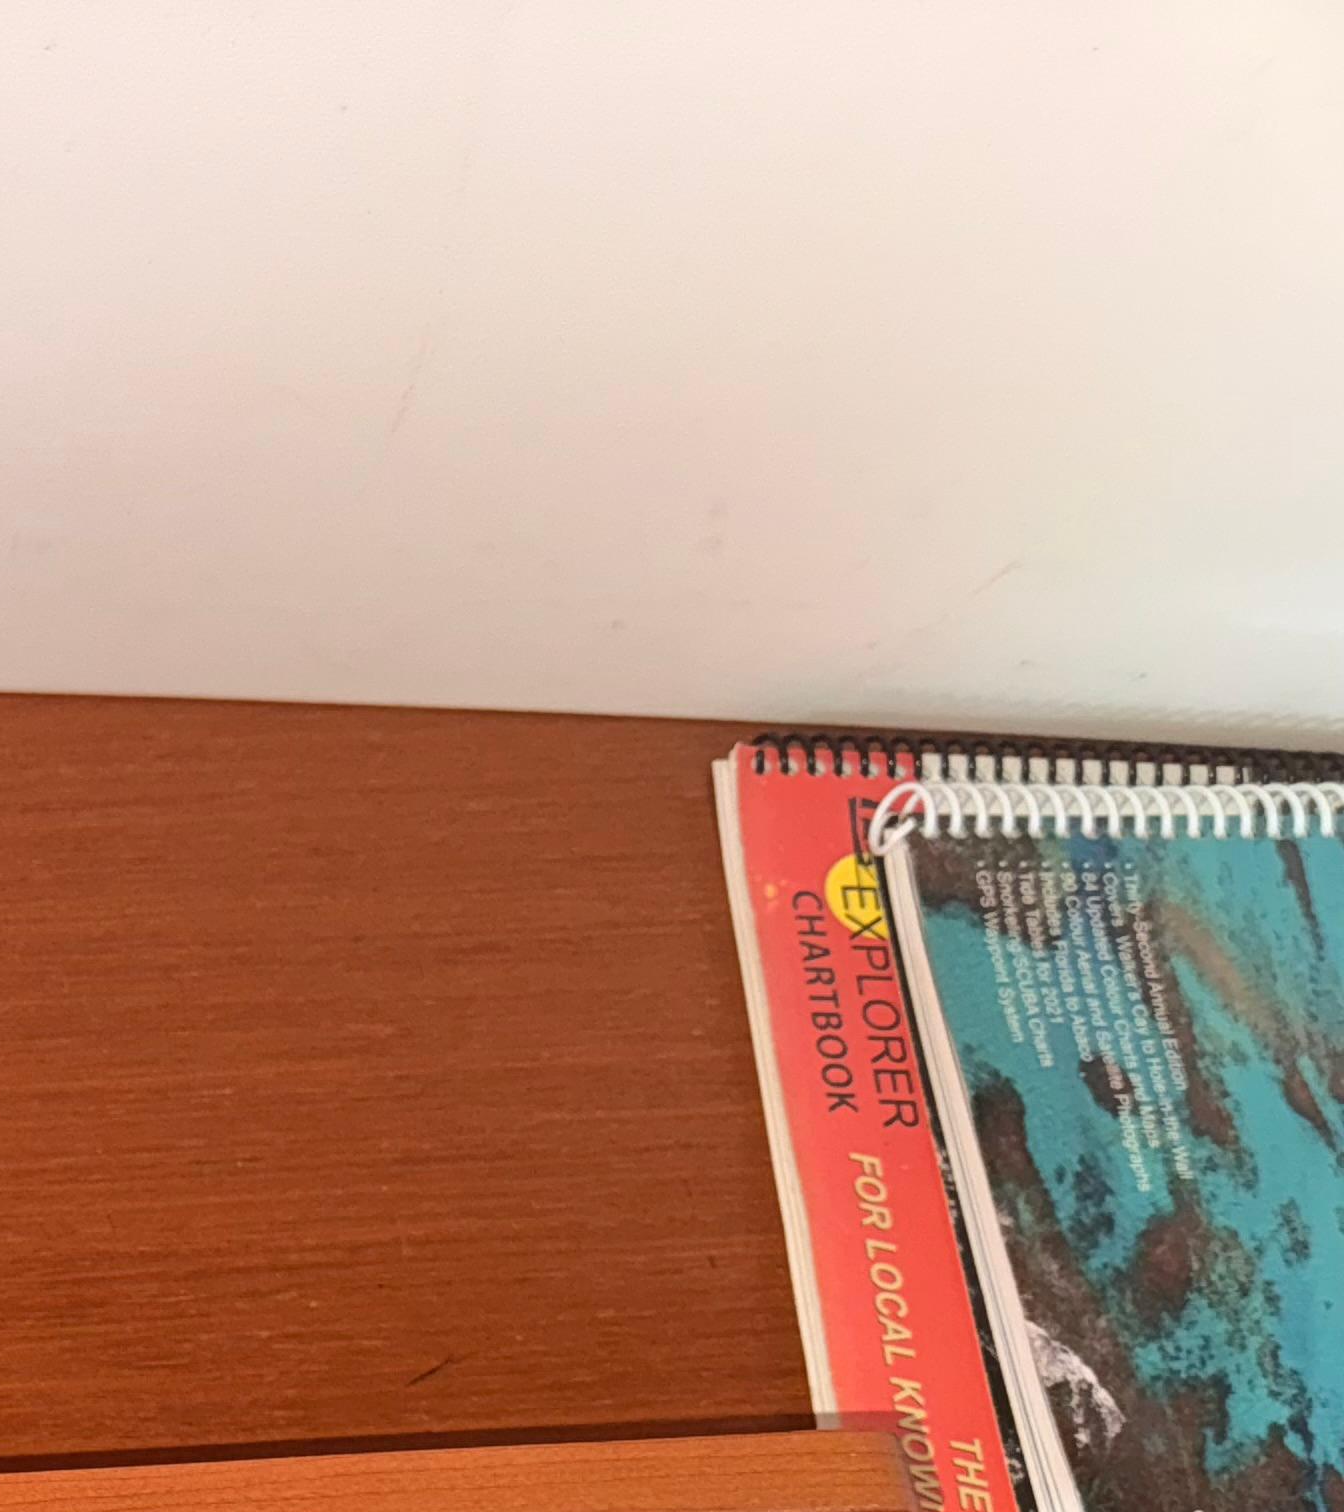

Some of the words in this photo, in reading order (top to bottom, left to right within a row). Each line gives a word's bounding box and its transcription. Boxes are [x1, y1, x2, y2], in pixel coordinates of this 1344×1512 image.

[975, 870, 996, 908] GPS
[1018, 872, 1035, 905] Tide
[1039, 871, 1061, 936] Includes
[1024, 909, 1046, 959] Tables
[1065, 896, 1086, 947] Colour
[1086, 896, 1113, 961] Updated
[982, 912, 1010, 984] Waypoint
[1036, 961, 1051, 982] for
[1052, 939, 1076, 993] Florida
[1076, 949, 1097, 995] Aerial
[1102, 872, 1124, 927] Covers
[1131, 1004, 1150, 1035] Cay
[1141, 1039, 1156, 1054] to
[789, 888, 860, 1114] CHARTBOOK
[841, 884, 920, 1131] EXPLORER
[1041, 985, 1064, 1023] 2021
[1065, 996, 1080, 1011] to
[1100, 964, 1123, 1015] Colour
[1123, 873, 1160, 980] Thirty-Second
[1146, 981, 1175, 1035] Annual
[1162, 1038, 1188, 1091] Edition
[998, 987, 1024, 1043] System
[1071, 1014, 1093, 1062] Abaco
[1086, 997, 1107, 1028] and
[1028, 1018, 1054, 1068] Charts
[1095, 1031, 1123, 1090] Satellite
[1113, 1019, 1138, 1069] Charts
[1128, 1072, 1149, 1102] and
[1113, 1093, 1152, 1193] Photographs
[1138, 1105, 1161, 1149] Maps
[848, 1151, 892, 1232] FOR
[868, 1239, 915, 1367] LOCAL
